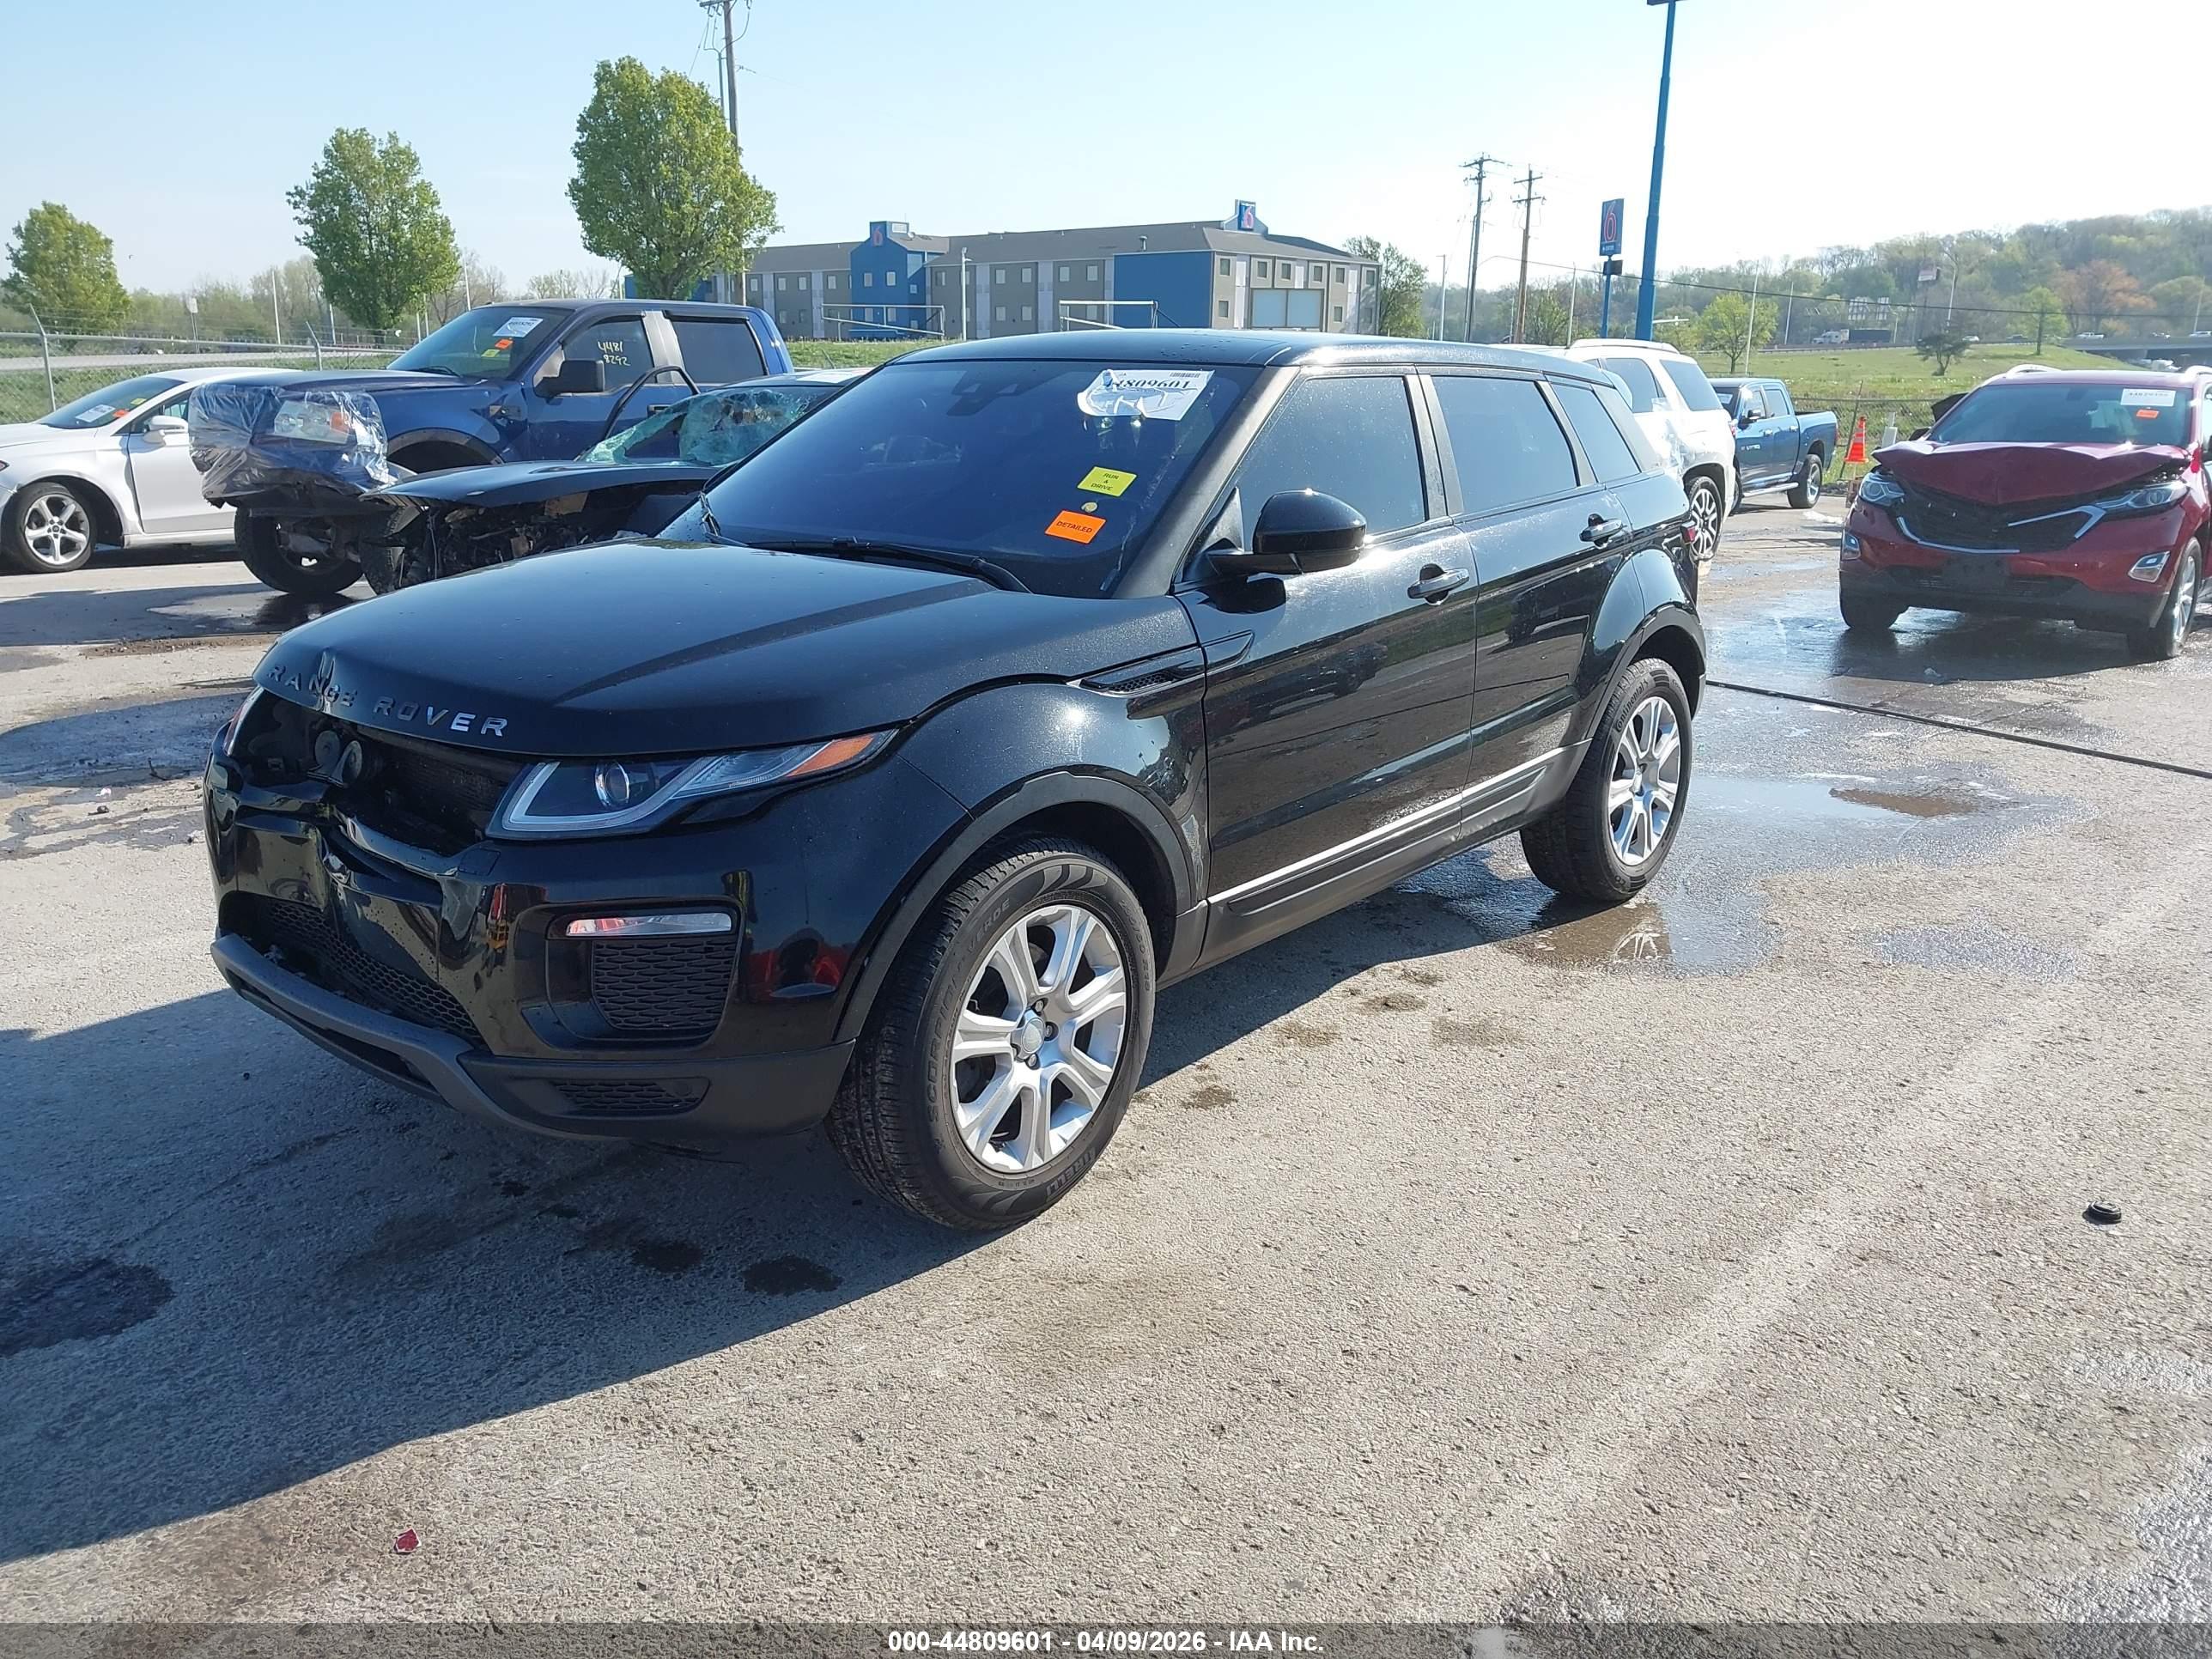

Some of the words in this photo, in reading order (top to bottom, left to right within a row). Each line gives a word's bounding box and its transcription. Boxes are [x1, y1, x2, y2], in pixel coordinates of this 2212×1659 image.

[1604, 200, 1617, 243] 6
[597, 340, 624, 354] 4481
[603, 353, 631, 367] 8292
[1091, 483, 1114, 491] DRIVE
[1056, 520, 1093, 533] DETAILED
[267, 665, 357, 708] RANGE
[373, 695, 509, 737] ROVER
